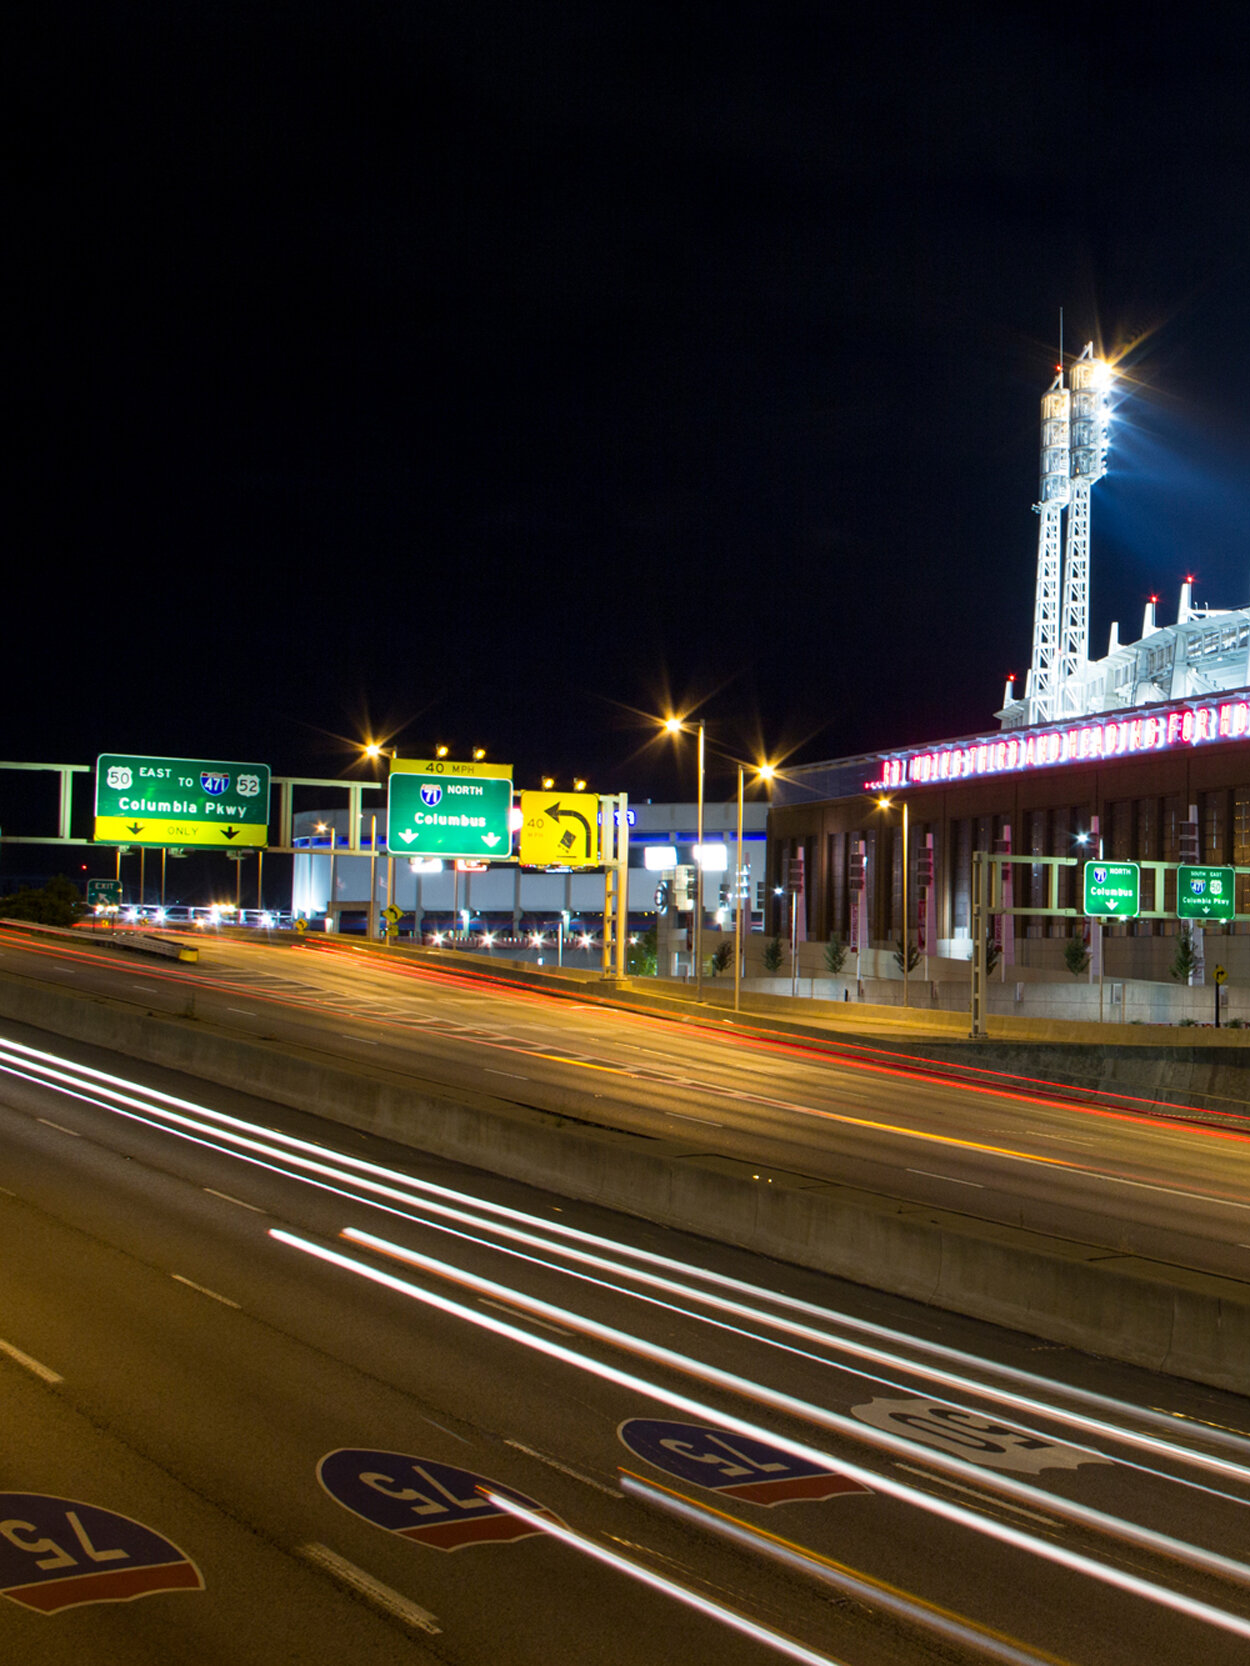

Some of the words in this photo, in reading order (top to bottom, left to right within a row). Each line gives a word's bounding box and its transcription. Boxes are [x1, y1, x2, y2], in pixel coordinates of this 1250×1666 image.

[969, 738, 1025, 774] THIRD
[1026, 732, 1068, 766] AND
[1068, 718, 1166, 759] HEADING
[1167, 707, 1218, 744] FOR
[425, 763, 445, 774] 40
[452, 765, 475, 775] MPH
[109, 771, 131, 785] 50
[139, 767, 172, 778] EAST
[178, 777, 194, 788] TO
[204, 778, 226, 791] 471
[239, 779, 258, 792] 52
[424, 788, 438, 802] 71
[447, 785, 483, 796] NORTH
[118, 797, 198, 813] Columbia
[205, 802, 247, 818] Pkwy
[414, 812, 487, 827] Columbus
[527, 818, 544, 829] 40
[167, 826, 199, 836] ONLY
[1090, 886, 1133, 897] Columbus
[659, 1434, 791, 1477] 75
[358, 1464, 494, 1515] 75
[0, 1511, 130, 1570] 75
